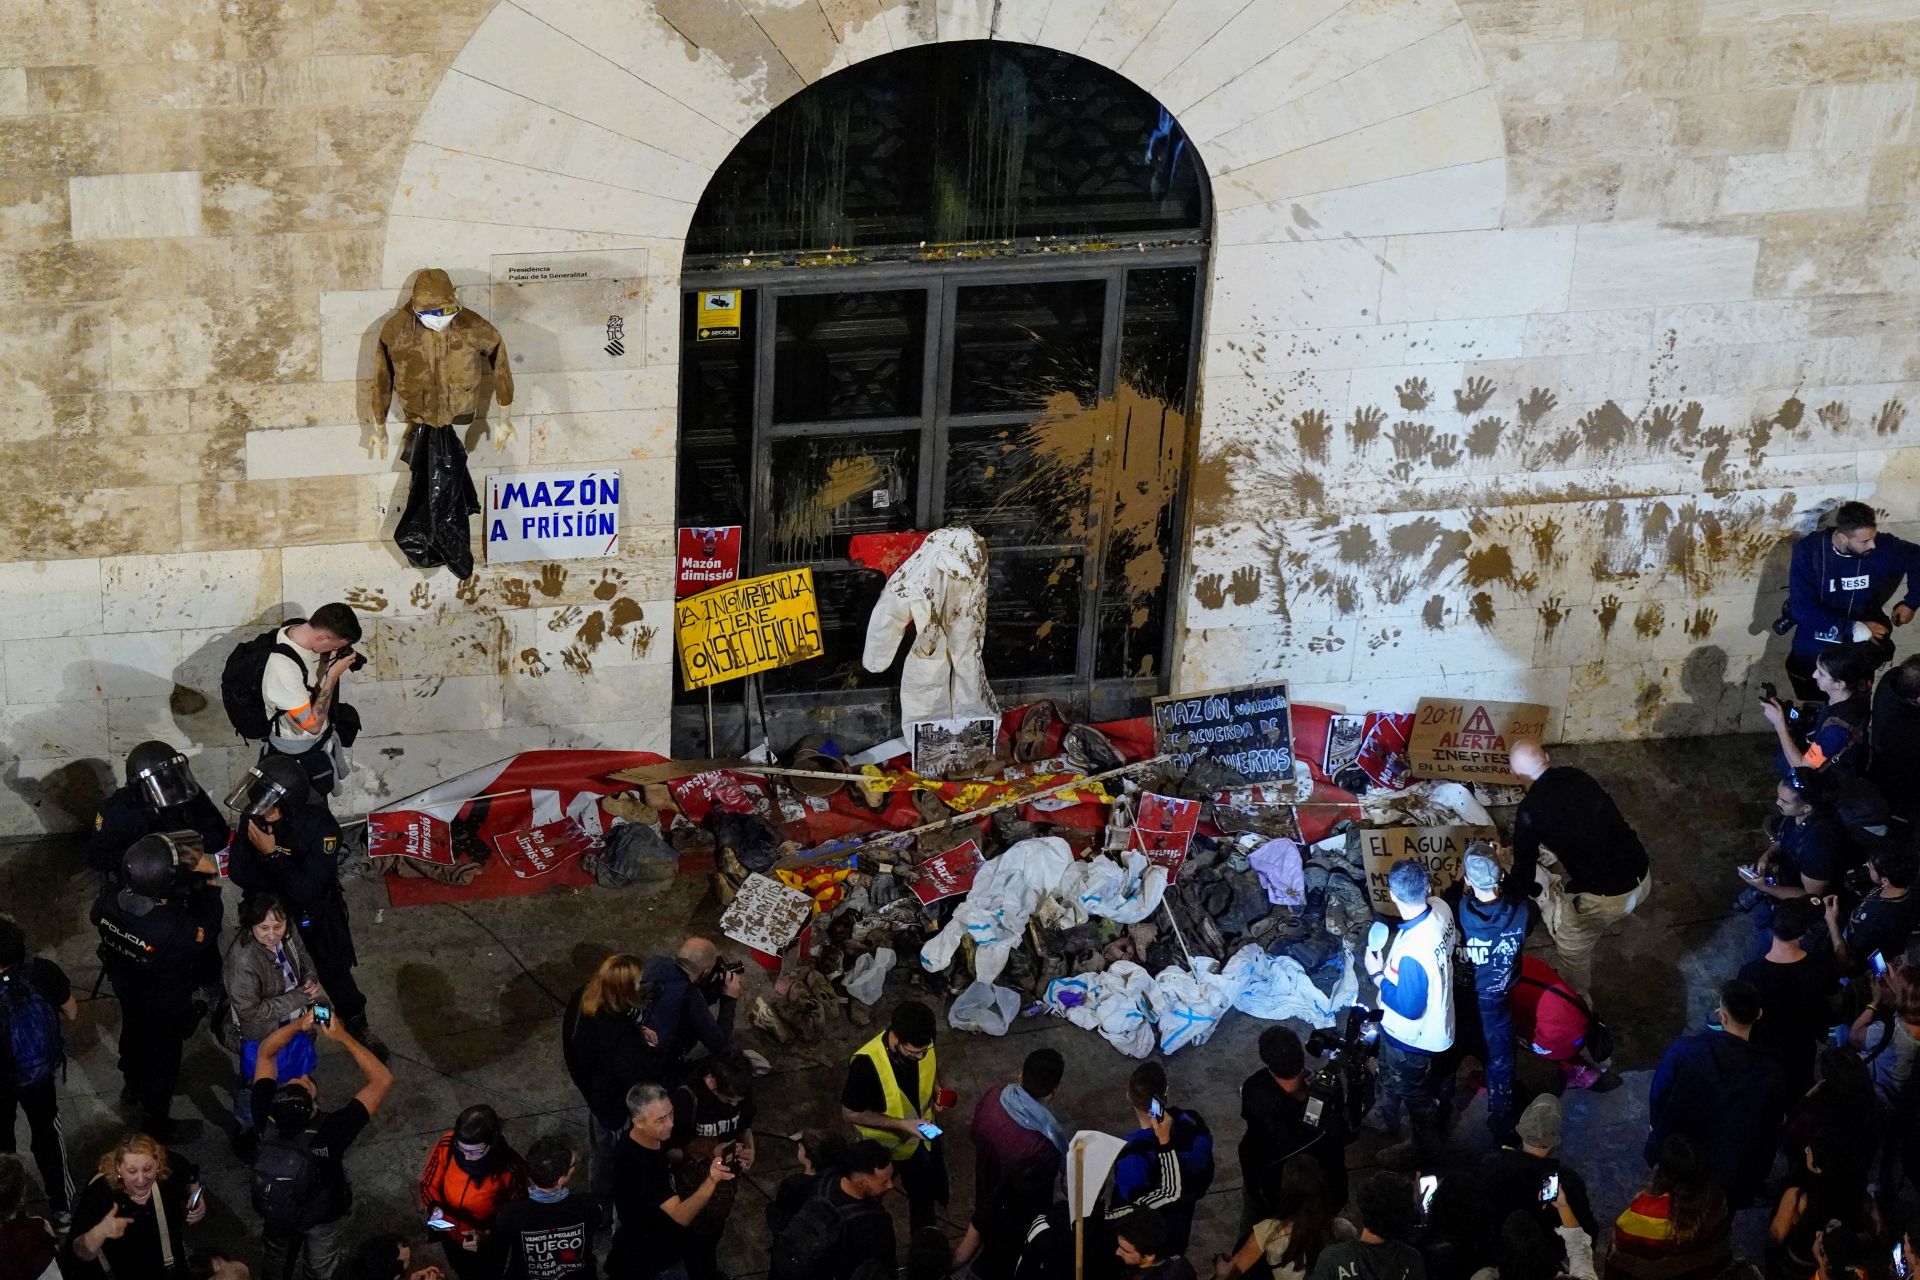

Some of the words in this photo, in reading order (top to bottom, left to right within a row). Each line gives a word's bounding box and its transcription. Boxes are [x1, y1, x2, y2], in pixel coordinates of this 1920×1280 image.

[549, 271, 588, 279] Generalitat
[489, 519, 509, 542] A
[681, 557, 722, 569] Mazón
[681, 569, 734, 581] dimissió
[677, 605, 700, 629] LA
[700, 573, 813, 621] INCOMPETENCIA
[714, 607, 777, 634] TIENE
[684, 612, 821, 683] CONSECUENCIAS
[1420, 705, 1464, 725] 20:11
[1187, 722, 1254, 745] ACUERDA
[1260, 717, 1279, 733] DE
[1439, 731, 1506, 751] ALERTA
[1432, 749, 1511, 764] INEPTES
[1418, 762, 1433, 771] EN
[1438, 763, 1455, 772] LA
[529, 829, 554, 858] Maón
[1369, 836, 1393, 857] EL
[1404, 836, 1457, 854] AGUA
[101, 918, 146, 949] POLICIA
[554, 1229, 582, 1239] PEGARLE
[525, 1237, 582, 1254] FUEGO
[528, 1260, 557, 1270] CASA
[537, 1252, 554, 1262] LA
